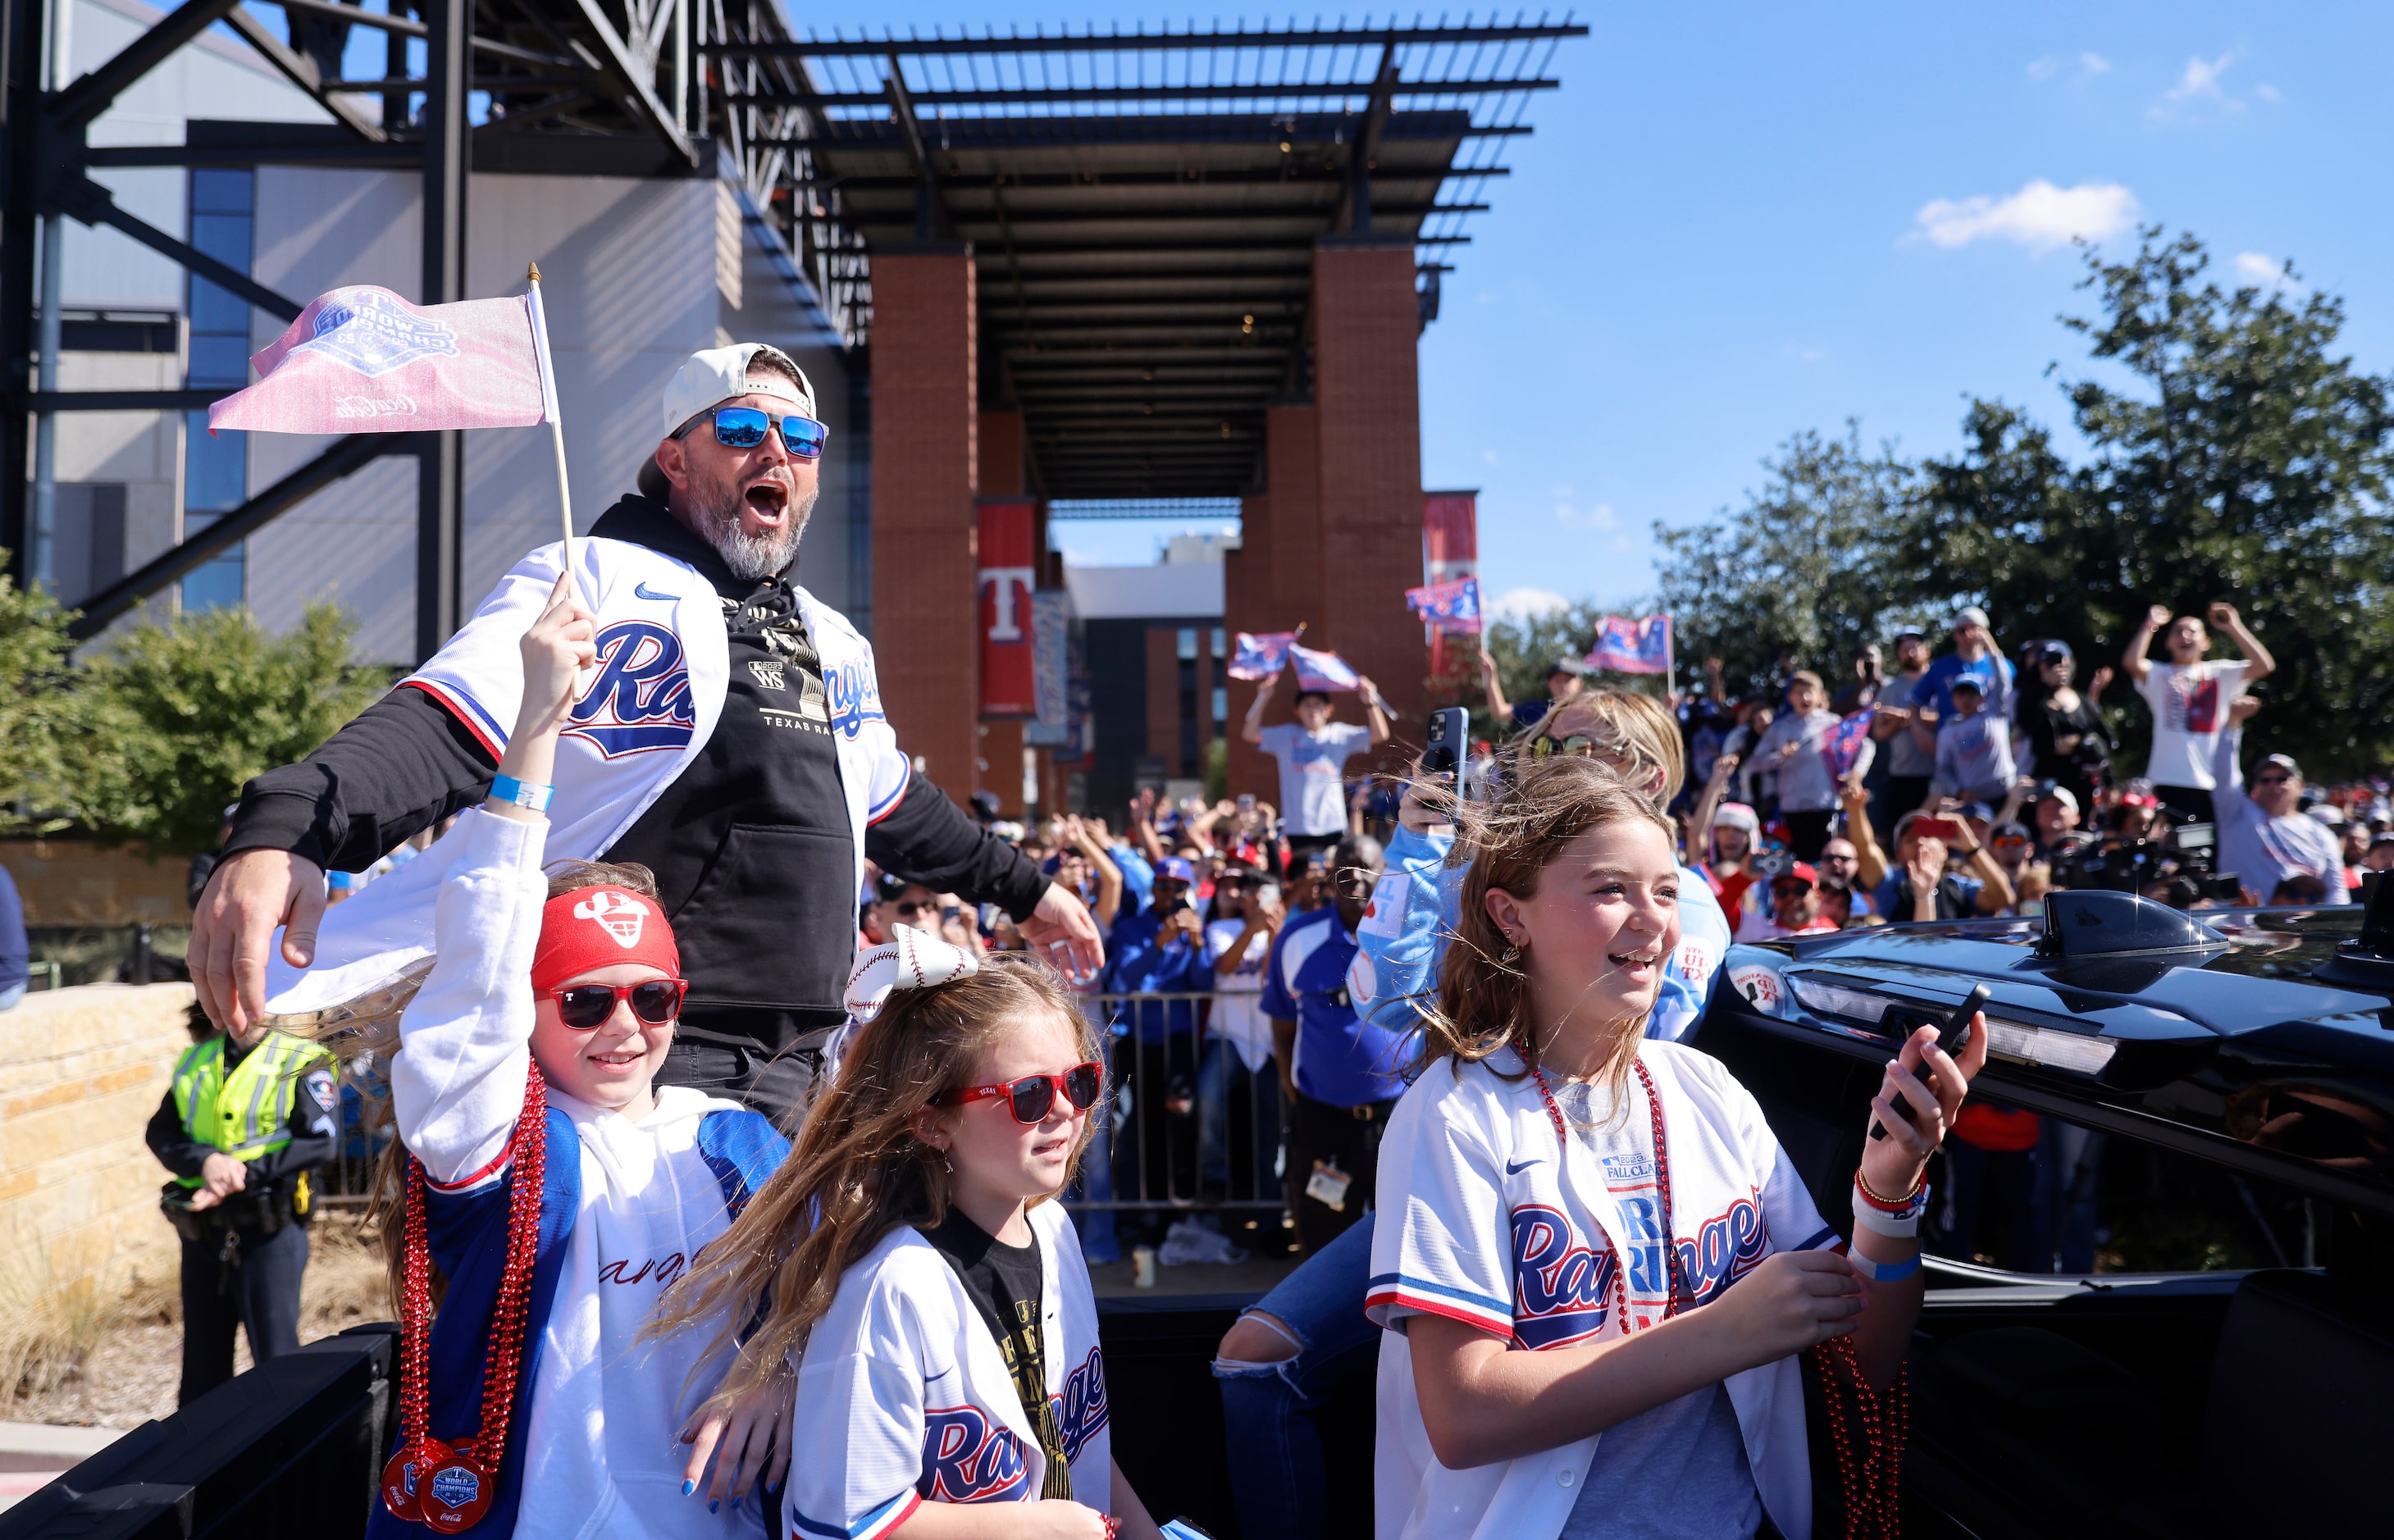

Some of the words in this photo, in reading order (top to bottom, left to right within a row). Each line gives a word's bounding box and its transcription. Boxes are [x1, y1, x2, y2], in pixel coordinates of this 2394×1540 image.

[978, 567, 1035, 644] T
[750, 671, 785, 689] WS
[764, 717, 810, 731] TEXAS
[979, 1087, 996, 1096] TEXAS
[1621, 1155, 1644, 1164] 2023
[1607, 1166, 1630, 1178] FALL
[454, 1469, 461, 1478] T
[445, 1477, 467, 1486] WORLD
[436, 1484, 475, 1495] CHAMPIONS
